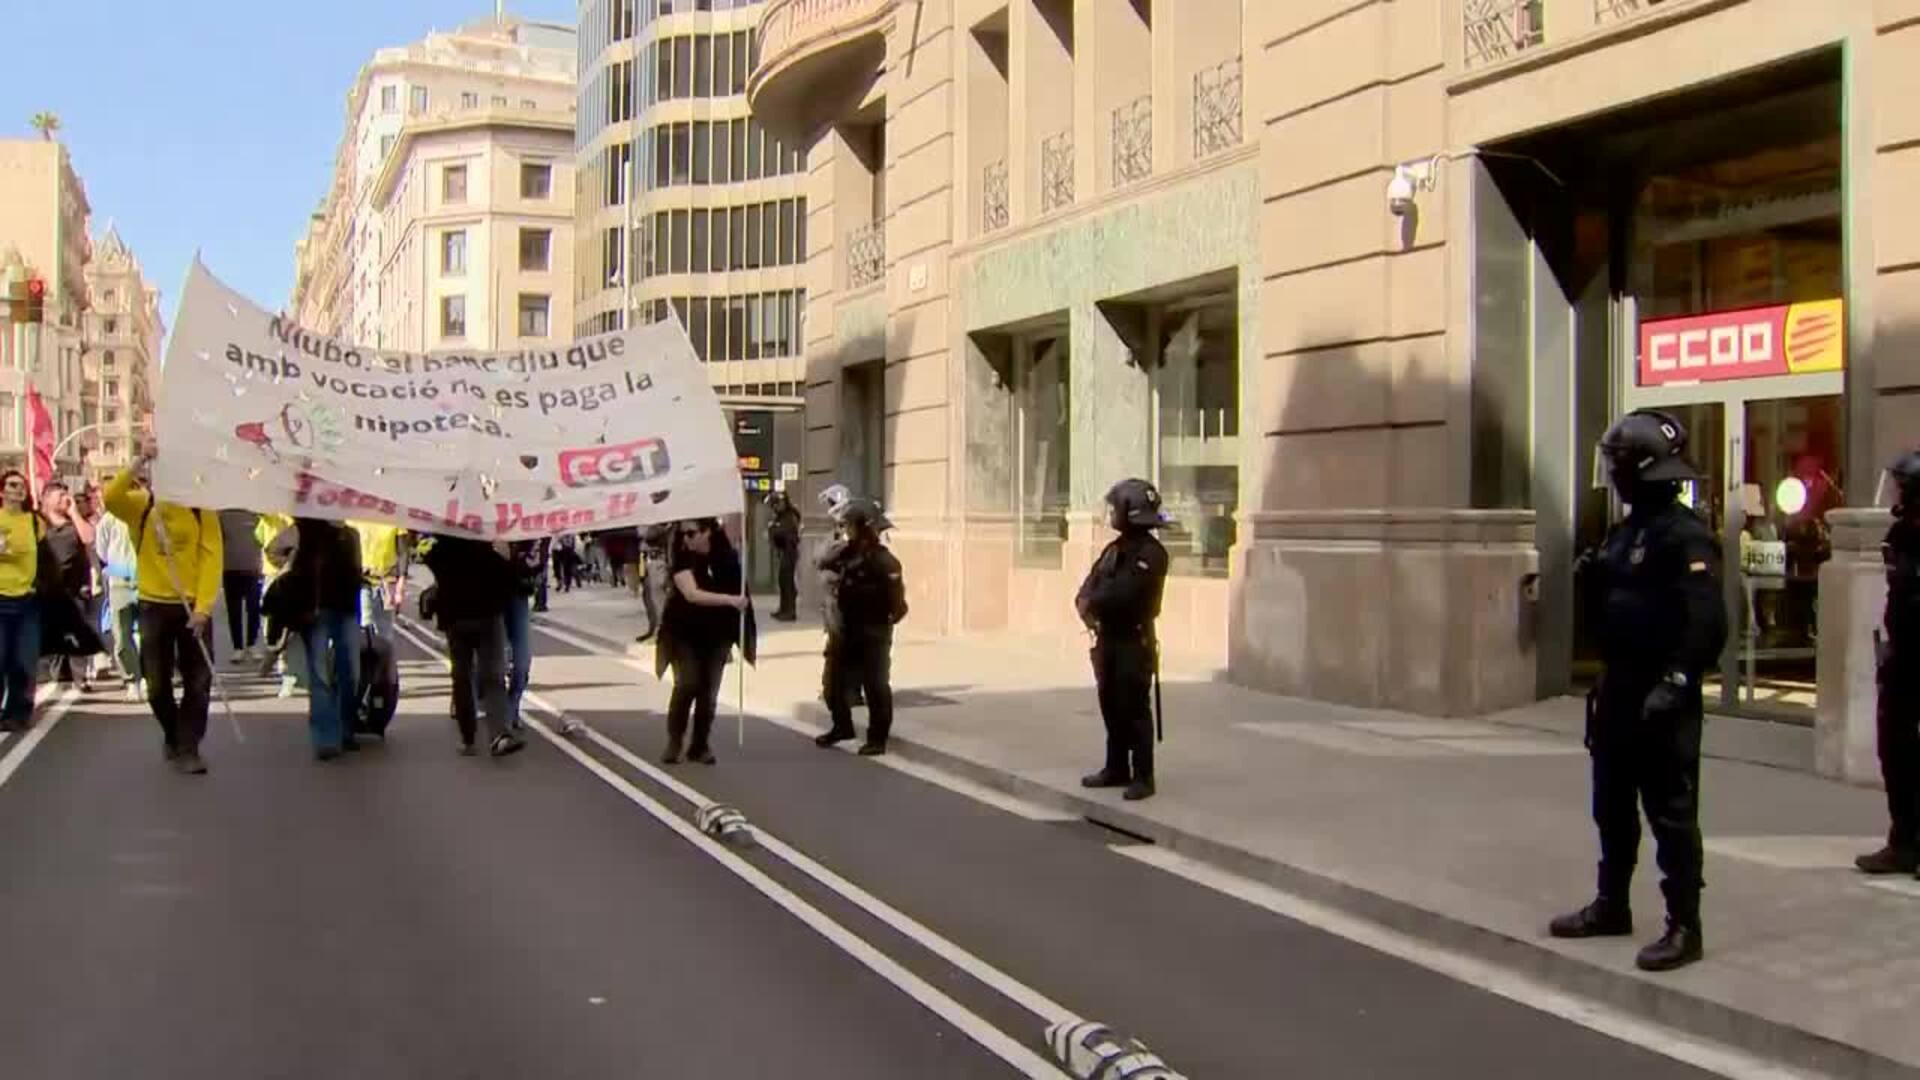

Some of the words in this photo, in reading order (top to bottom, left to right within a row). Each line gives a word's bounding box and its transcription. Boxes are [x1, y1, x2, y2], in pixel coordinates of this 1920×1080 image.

[507, 352, 558, 373] diu
[567, 336, 624, 368] que
[1650, 321, 1772, 372] CCOO
[225, 342, 300, 379] amb
[311, 370, 440, 399] vocació
[451, 379, 485, 400] no
[496, 388, 529, 408] es
[539, 382, 616, 415] paga
[625, 371, 653, 395] la
[569, 443, 659, 483] CGT
